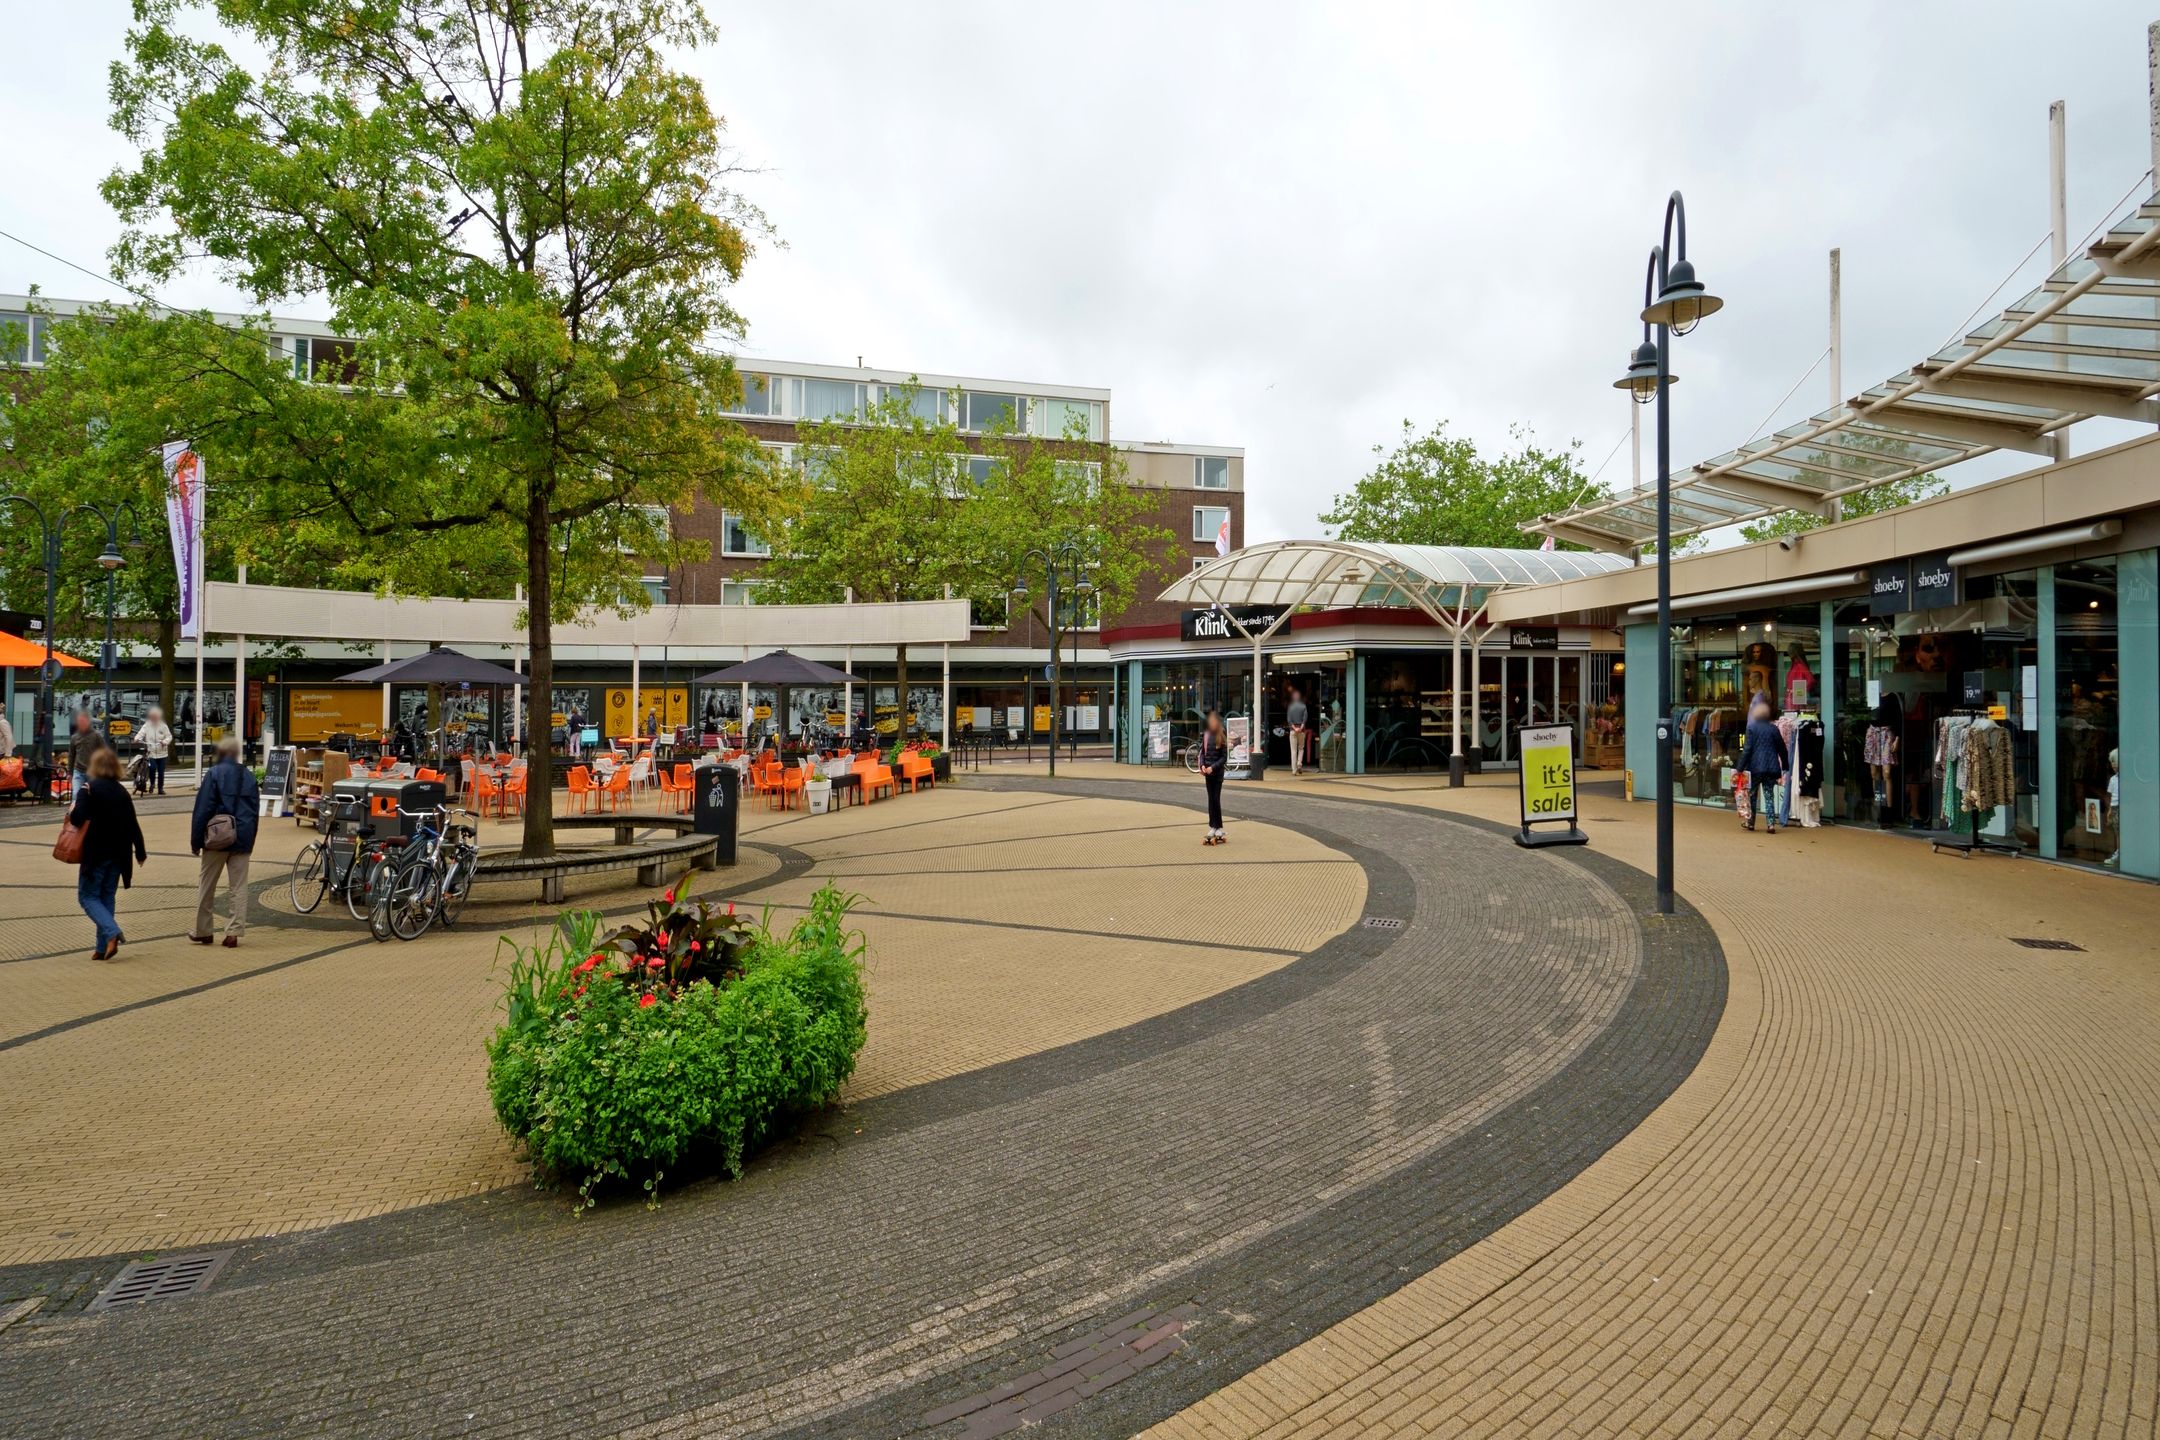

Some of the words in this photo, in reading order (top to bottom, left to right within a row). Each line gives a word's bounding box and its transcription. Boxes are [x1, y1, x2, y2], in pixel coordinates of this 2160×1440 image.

[1874, 575, 1905, 594] shoeby
[1918, 568, 1951, 587] shoeby
[1195, 611, 1231, 638] Klink
[1513, 632, 1533, 647] Klink
[1533, 732, 1557, 741] shoeby
[1543, 764, 1571, 785] it's
[1532, 792, 1572, 813] sale
